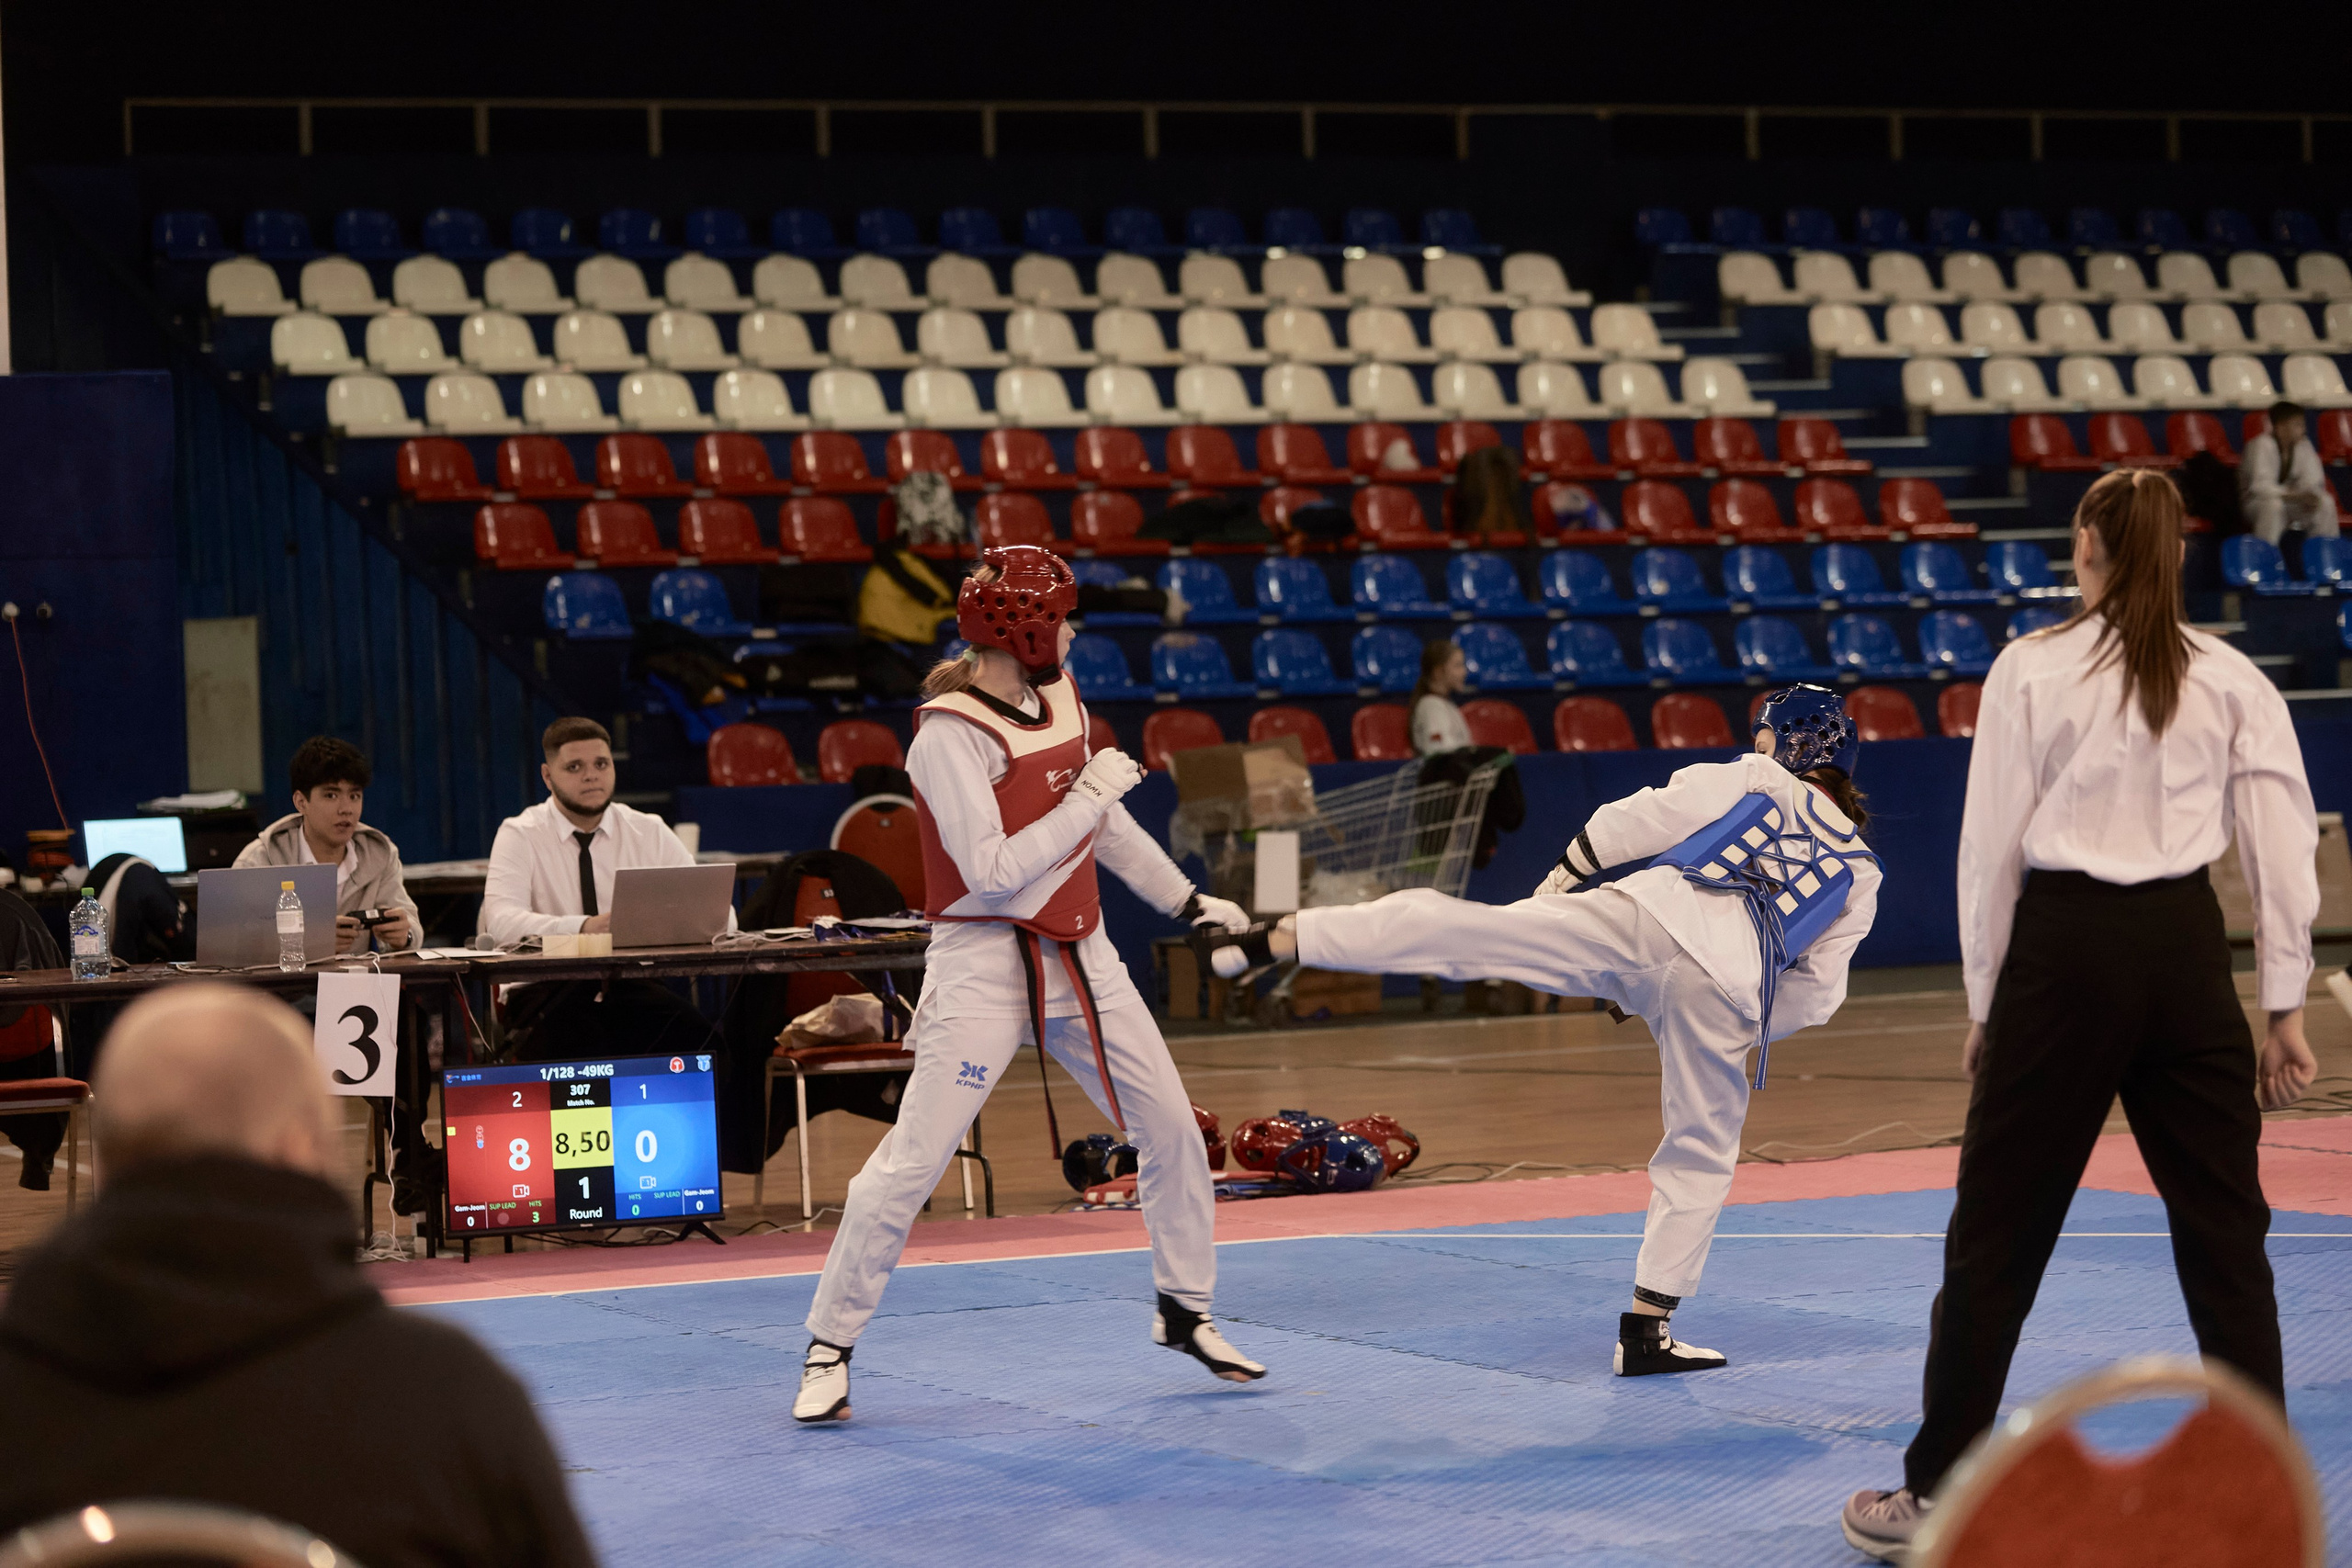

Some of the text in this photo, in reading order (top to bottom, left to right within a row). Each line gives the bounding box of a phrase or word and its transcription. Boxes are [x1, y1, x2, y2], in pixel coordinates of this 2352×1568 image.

[1080, 779, 1103, 797] KWON
[1075, 914, 1084, 931] 2
[331, 1004, 381, 1086] 3
[539, 1064, 615, 1081] 1/128 -49KG
[570, 1083, 591, 1096] 307
[639, 1083, 647, 1100] 1
[956, 1078, 985, 1089] KPNP
[512, 1090, 523, 1108] 2
[555, 1130, 611, 1157] 8,50
[635, 1129, 658, 1163] 0
[508, 1137, 532, 1172] 8
[578, 1176, 590, 1200] 1
[666, 1190, 681, 1199] LEAD
[502, 1201, 516, 1210] LEAD
[570, 1206, 603, 1220] Round
[631, 1204, 640, 1216] 0
[695, 1200, 704, 1212] 0
[466, 1215, 475, 1227] 0
[532, 1211, 540, 1224] 3
